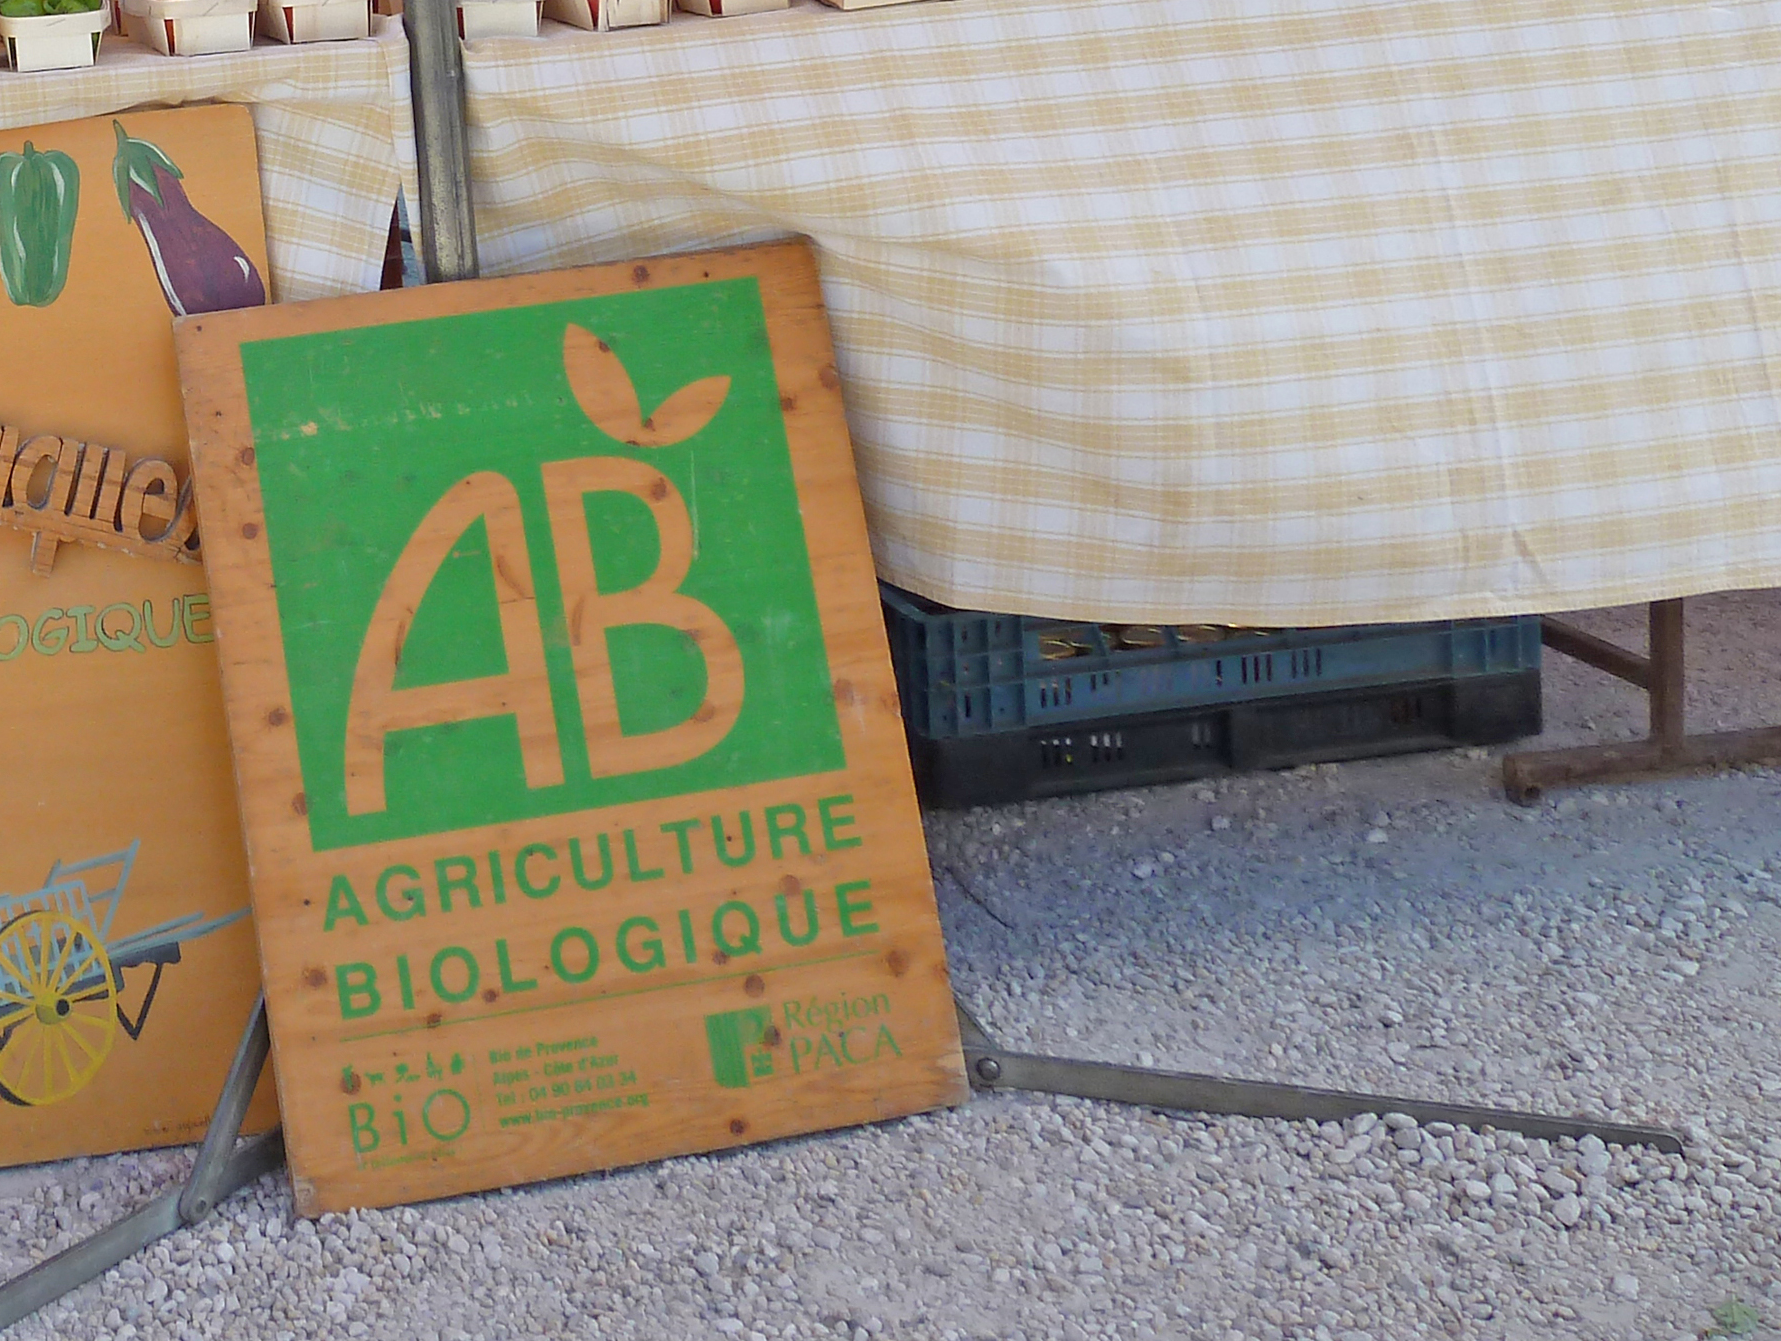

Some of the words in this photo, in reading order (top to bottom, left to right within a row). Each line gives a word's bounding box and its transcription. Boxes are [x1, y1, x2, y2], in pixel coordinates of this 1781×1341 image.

[343, 456, 747, 817] AB
[323, 793, 864, 933] AGRICULTURE
[334, 878, 880, 1021] BIOLOGIQUE
[535, 1035, 599, 1058] Provence
[782, 991, 892, 1033] Région
[788, 1021, 904, 1075] PACA
